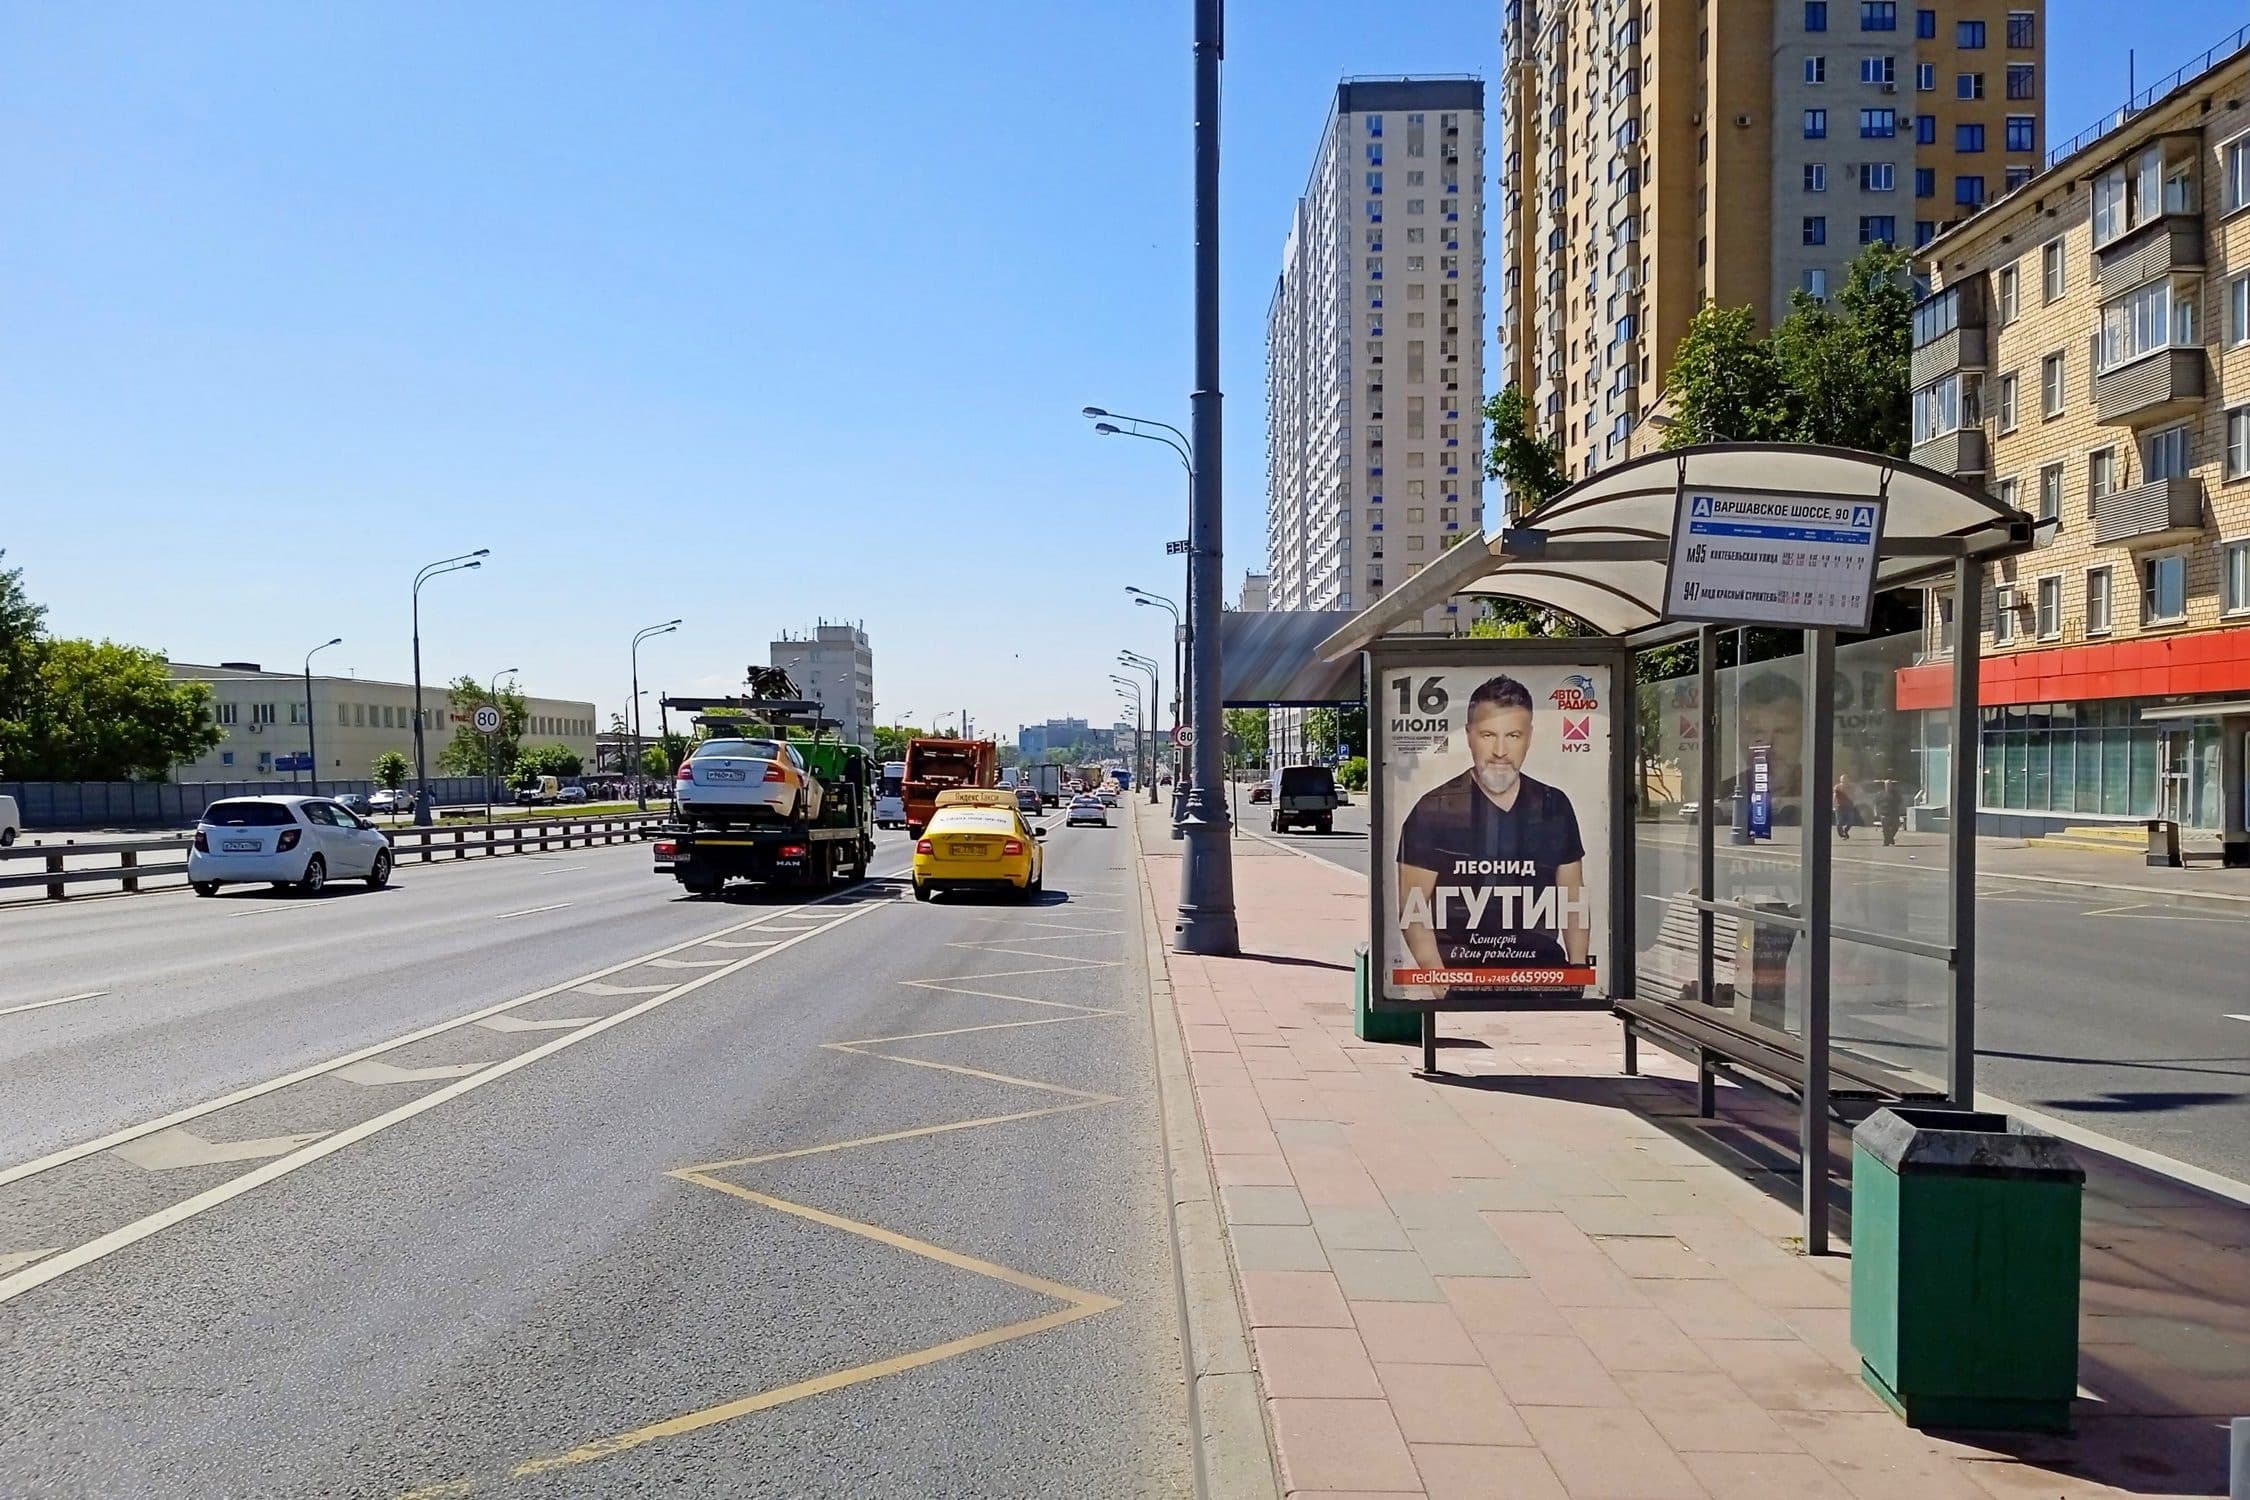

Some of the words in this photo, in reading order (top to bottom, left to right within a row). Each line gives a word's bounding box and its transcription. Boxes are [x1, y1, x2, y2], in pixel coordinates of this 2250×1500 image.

[1714, 500, 1788, 517] ВАРШАВСКОЕ
[1790, 505, 1832, 520] ШОССЕ,
[1835, 508, 1849, 520] 90
[1167, 541, 1188, 553] 336
[1686, 543, 1707, 563] М95
[1683, 581, 1700, 601] 947
[1392, 676, 1449, 715] 16
[1549, 689, 1581, 700] АВТО
[1558, 700, 1598, 710] РАДИО
[478, 712, 496, 726] 80
[1392, 719, 1449, 732] ИЮЛЯ
[1180, 732, 1192, 741] 80
[1562, 744, 1591, 753] МУЗ
[955, 792, 979, 802] Яндекс
[981, 792, 999, 801] Такси
[1453, 861, 1536, 876] ЛЕОНИД
[1401, 887, 1590, 930] АГУТИН
[1469, 933, 1517, 949] Концерт
[1460, 947, 1482, 959] день
[1481, 947, 1536, 963] рождения
